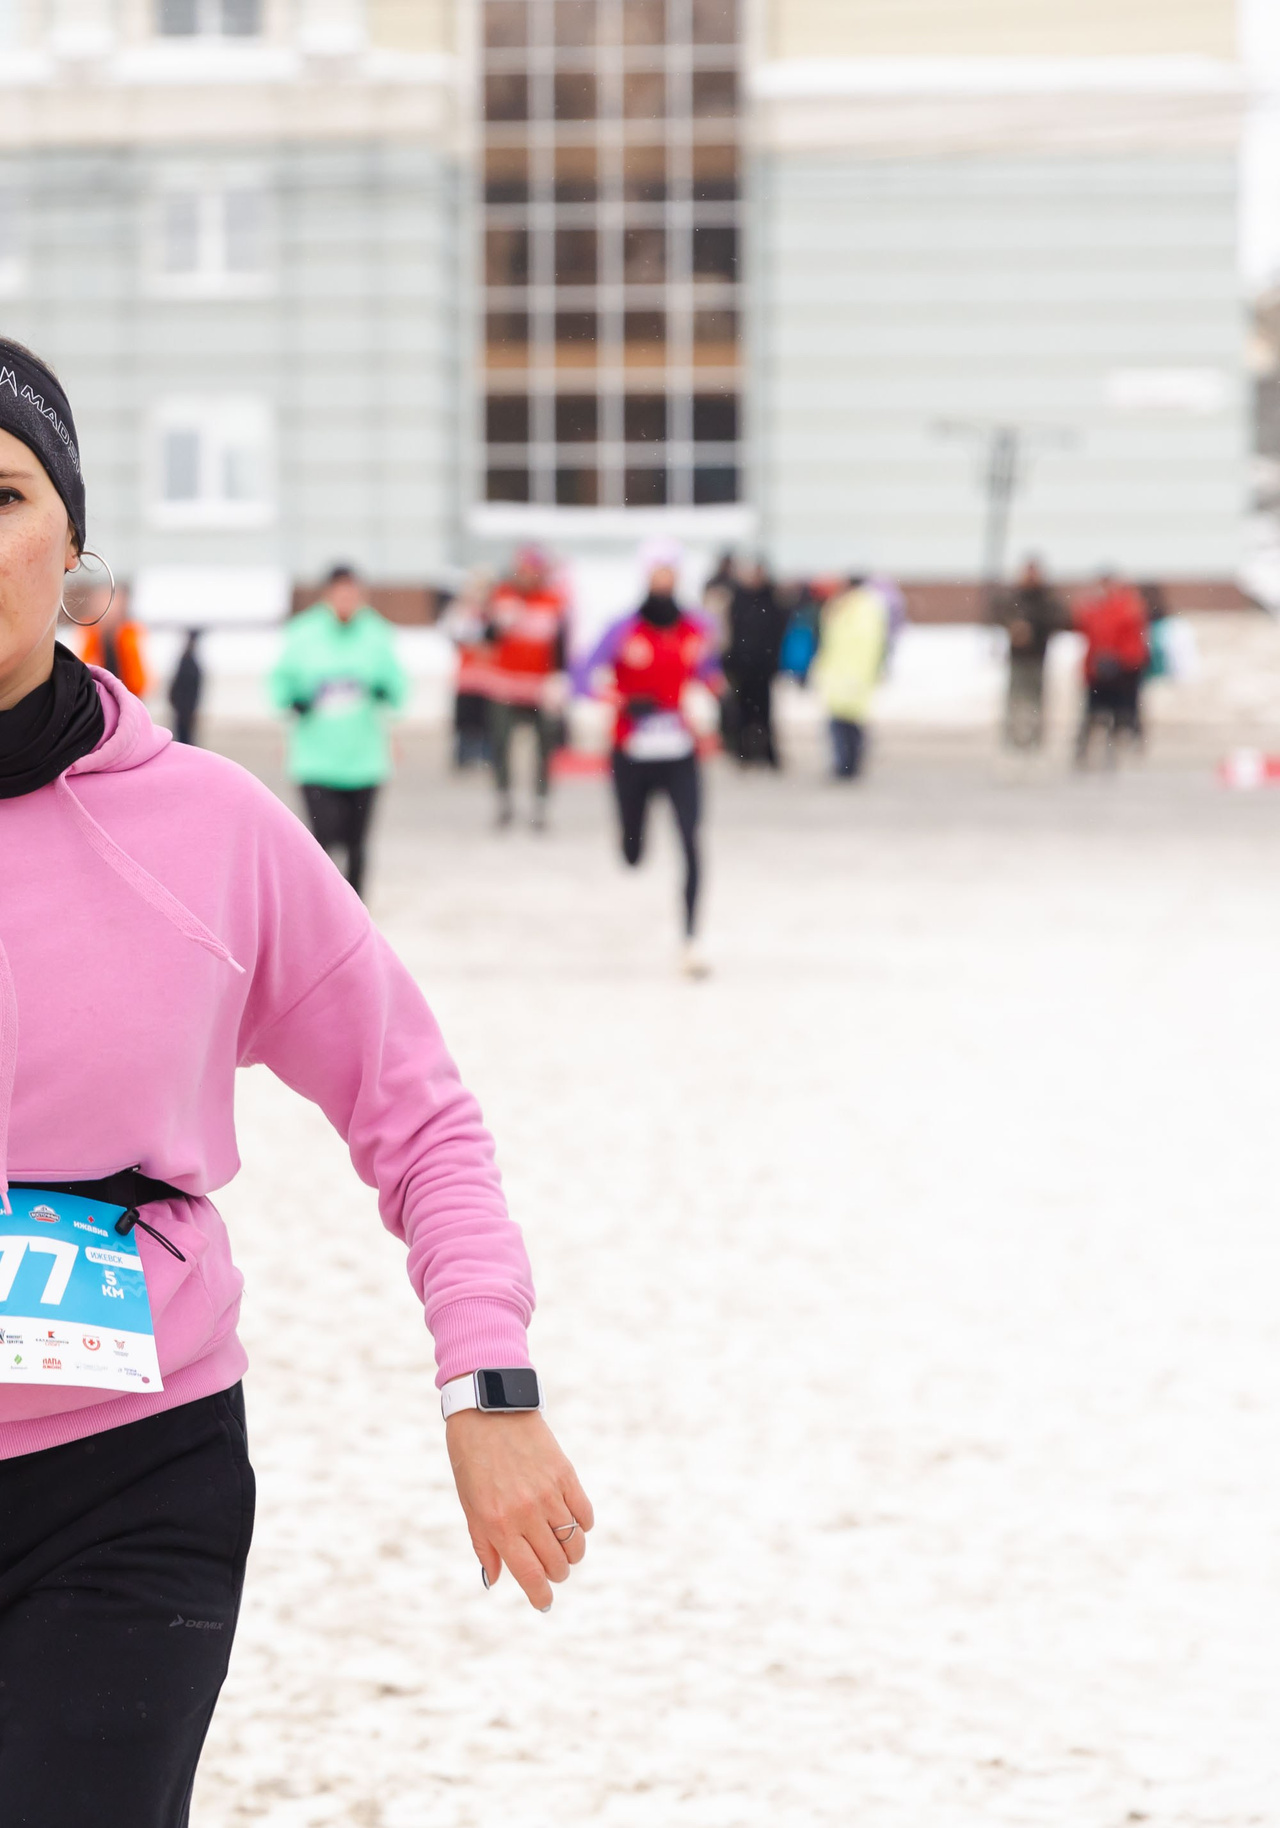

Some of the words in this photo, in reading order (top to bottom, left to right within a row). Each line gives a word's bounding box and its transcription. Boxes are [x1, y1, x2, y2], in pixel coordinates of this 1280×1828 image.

[20, 384, 80, 473] MADS
[90, 1251, 124, 1264] ИЖЕВСК
[104, 1270, 117, 1286] 5
[101, 1284, 125, 1300] КМ
